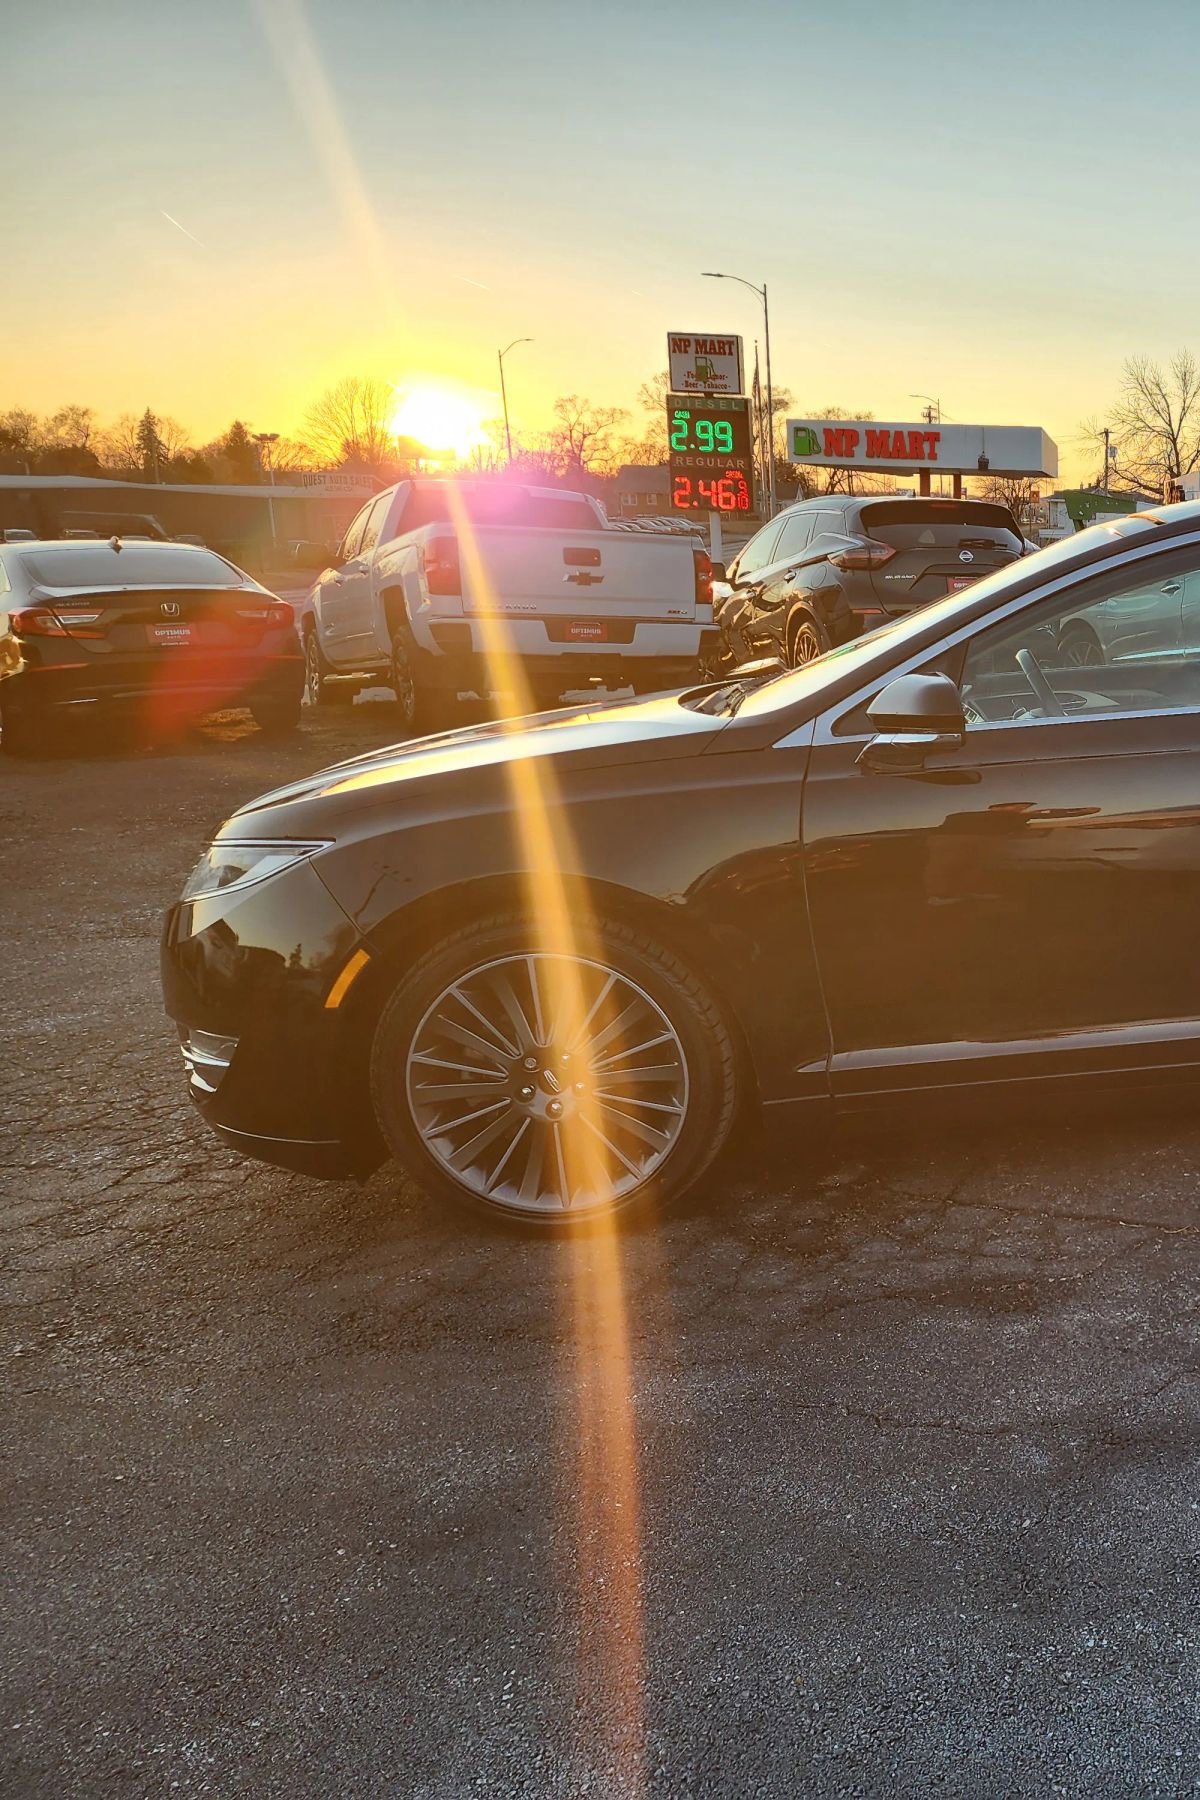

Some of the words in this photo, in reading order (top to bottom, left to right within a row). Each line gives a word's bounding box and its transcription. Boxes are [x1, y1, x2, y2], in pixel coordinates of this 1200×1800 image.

[671, 337, 691, 354] NP
[695, 338, 735, 356] MART
[674, 399, 739, 410] DIESEL
[671, 419, 733, 453] 2.99
[823, 428, 860, 458] NP
[865, 429, 941, 461] MART
[675, 456, 745, 469] REGULAR
[303, 474, 326, 487] QUEST
